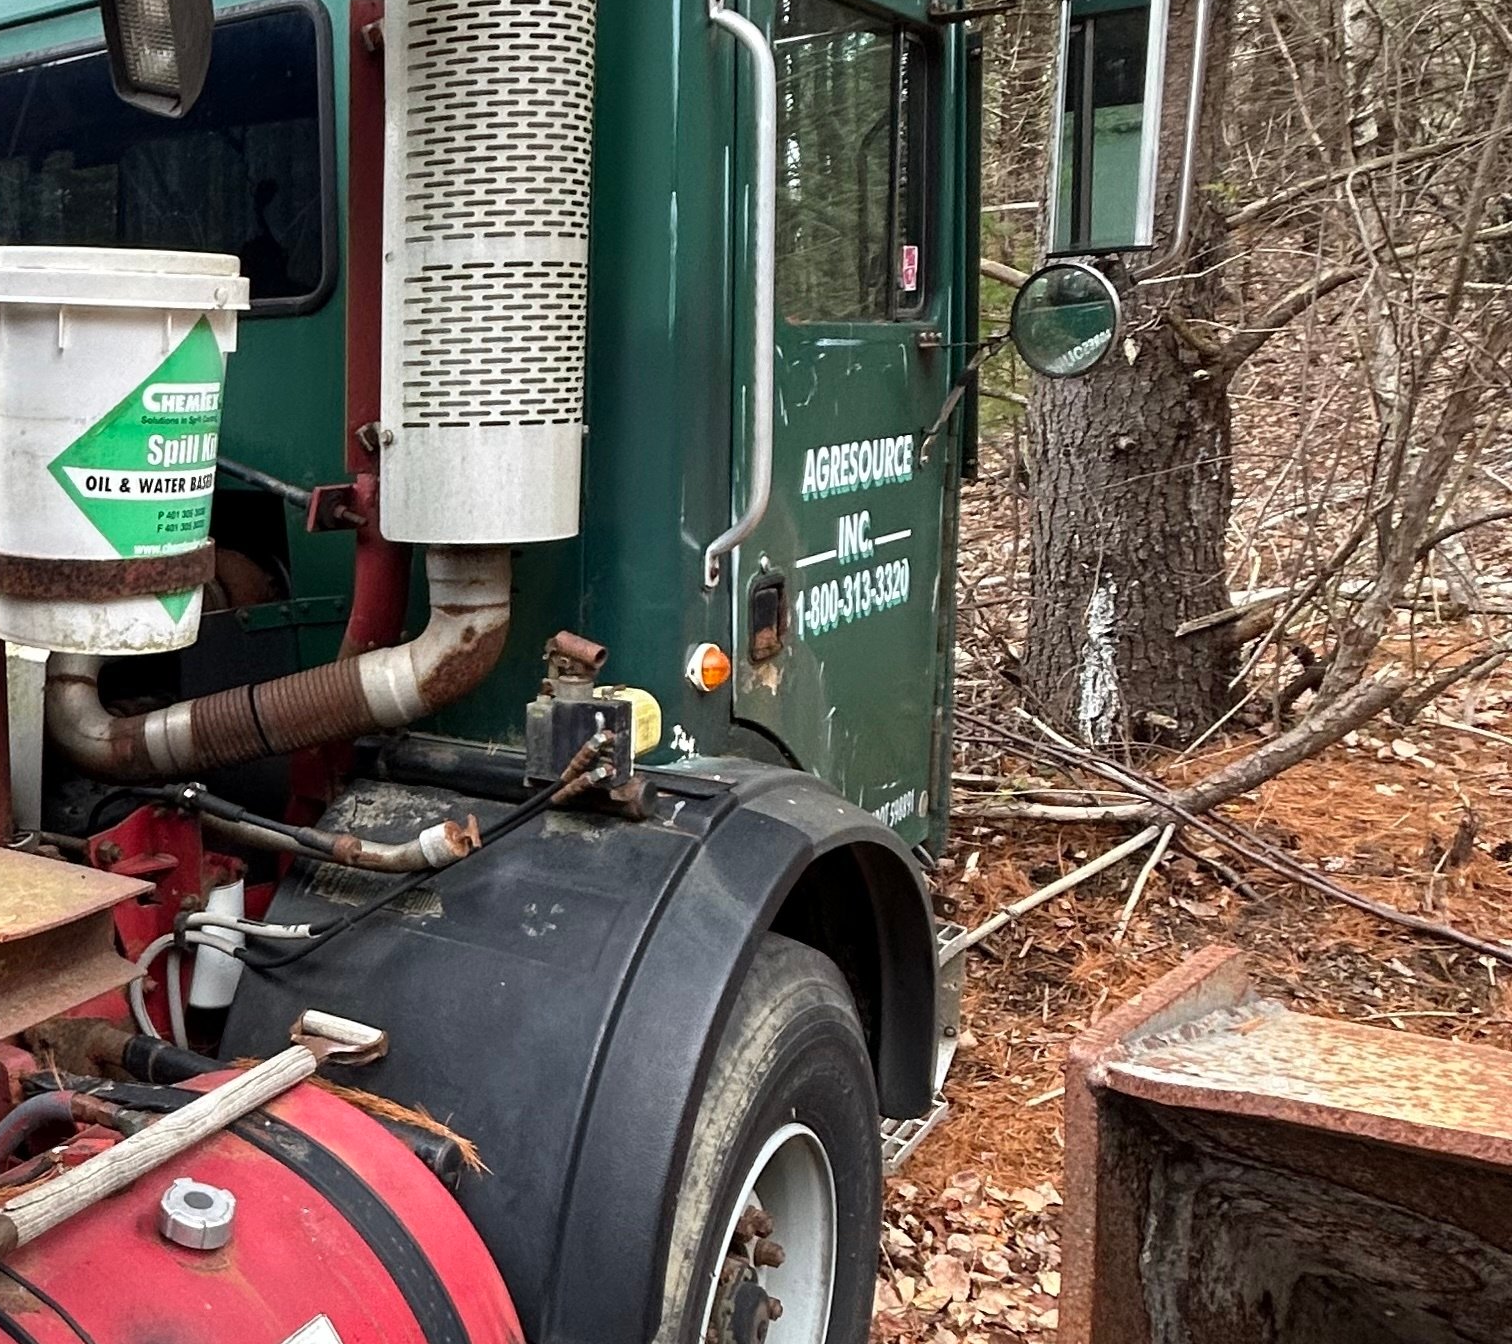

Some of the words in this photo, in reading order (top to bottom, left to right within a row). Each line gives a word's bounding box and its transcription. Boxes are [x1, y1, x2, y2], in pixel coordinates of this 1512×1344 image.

[147, 434, 200, 468] Spill
[801, 434, 914, 498] AGRESOURCE
[86, 475, 112, 492] OIL
[119, 477, 131, 493] &
[139, 477, 186, 494] WATER
[838, 509, 874, 560] INC.
[796, 558, 910, 637] 1-800-313-3320
